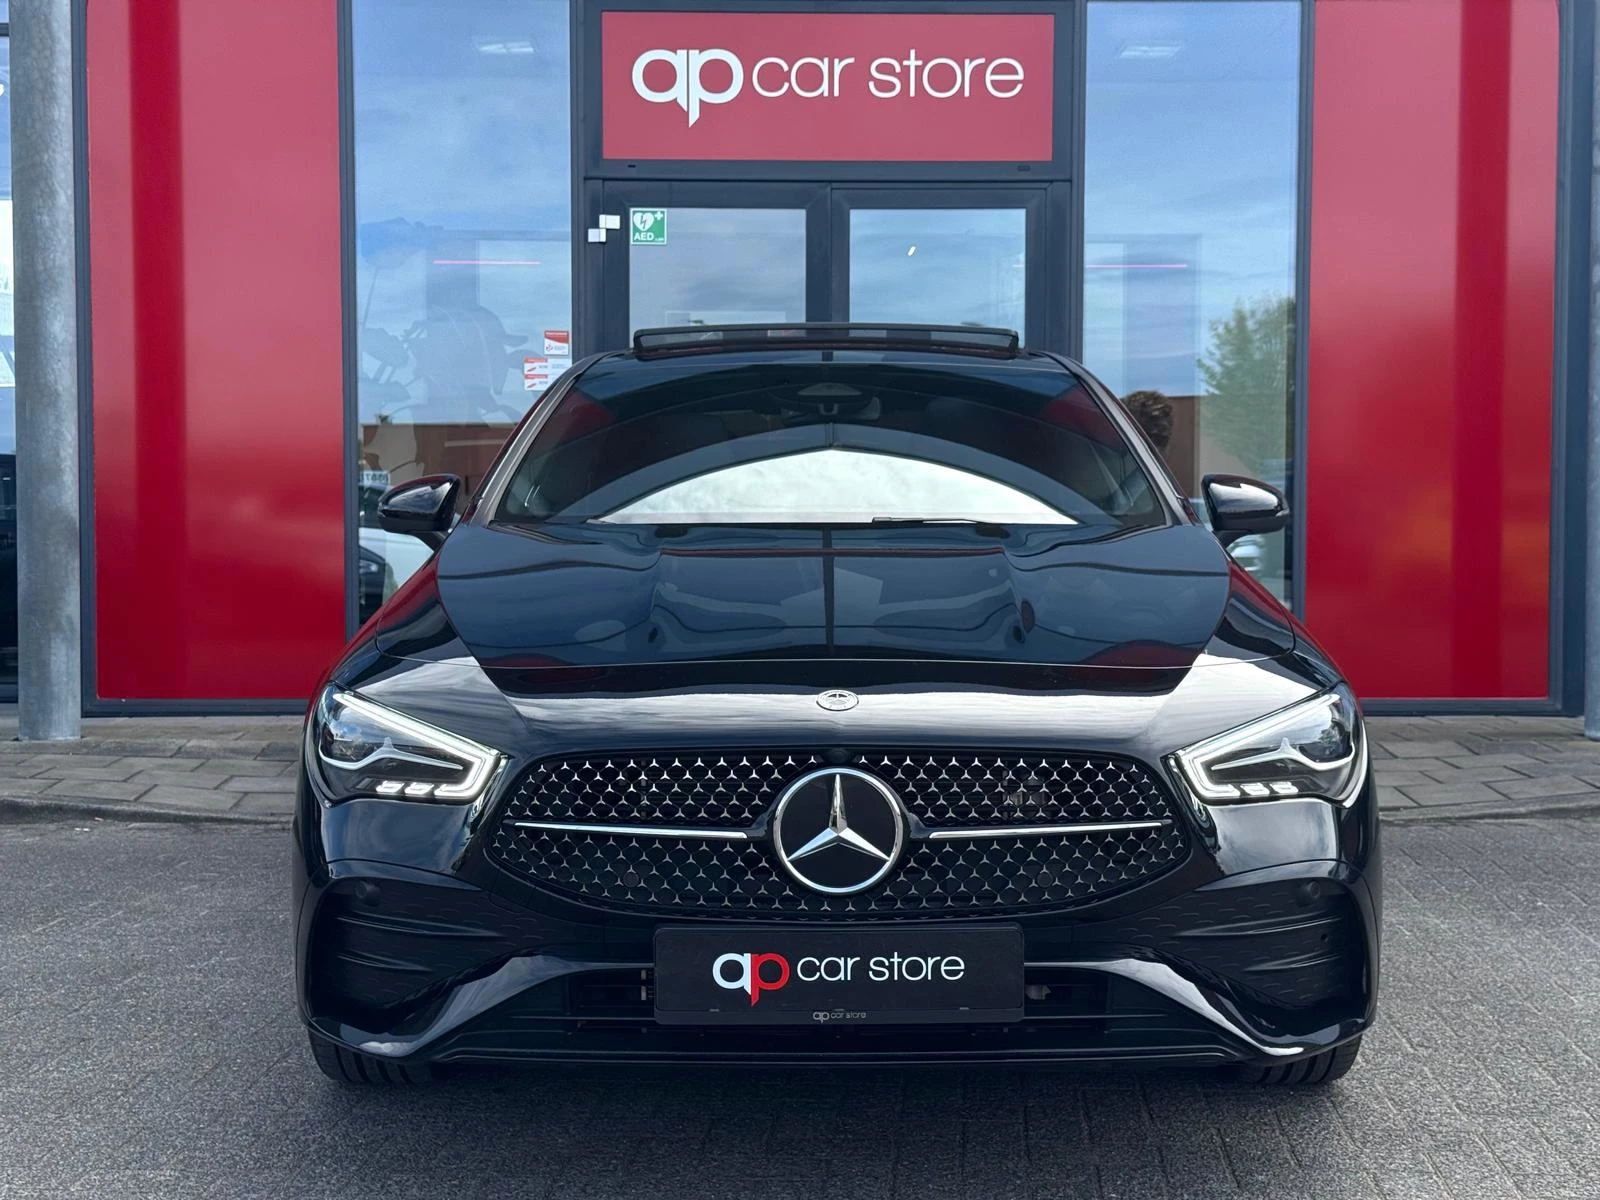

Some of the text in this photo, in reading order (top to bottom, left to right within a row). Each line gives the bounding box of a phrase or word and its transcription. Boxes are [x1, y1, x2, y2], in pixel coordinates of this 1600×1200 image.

[632, 48, 1025, 128] ap car store
[634, 232, 654, 241] AED
[713, 951, 965, 1006] ap car store
[812, 1011, 830, 1023] ap
[846, 1011, 867, 1019] store
